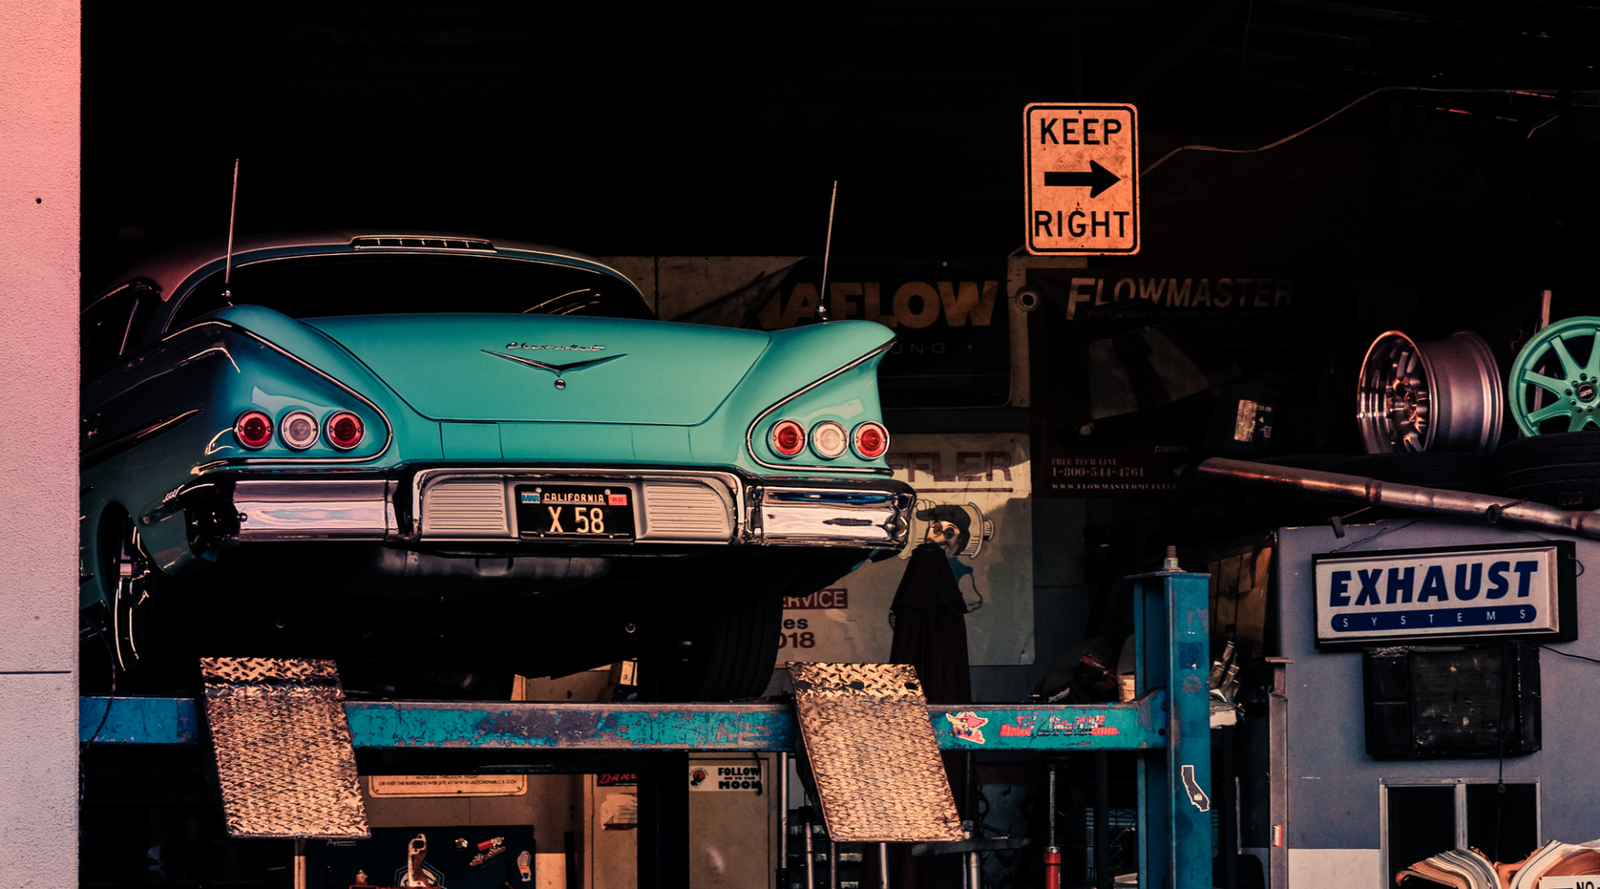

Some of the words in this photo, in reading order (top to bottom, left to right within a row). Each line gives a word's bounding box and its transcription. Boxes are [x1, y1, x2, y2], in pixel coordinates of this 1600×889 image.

[1041, 118, 1122, 145] KEEP
[1034, 210, 1129, 237] RIGHT
[1066, 277, 1295, 320] FLOWMASTER
[1052, 467, 1144, 477] 1-800-544-4761
[522, 494, 540, 502] MAR
[543, 492, 605, 503] CALIFORNIA
[547, 505, 564, 533] X
[574, 506, 605, 534] 58
[1330, 561, 1538, 607] EXHAUST
[1342, 608, 1526, 628] SYSTEMS
[718, 767, 760, 776] FOLLOW
[718, 780, 761, 789] MOON
